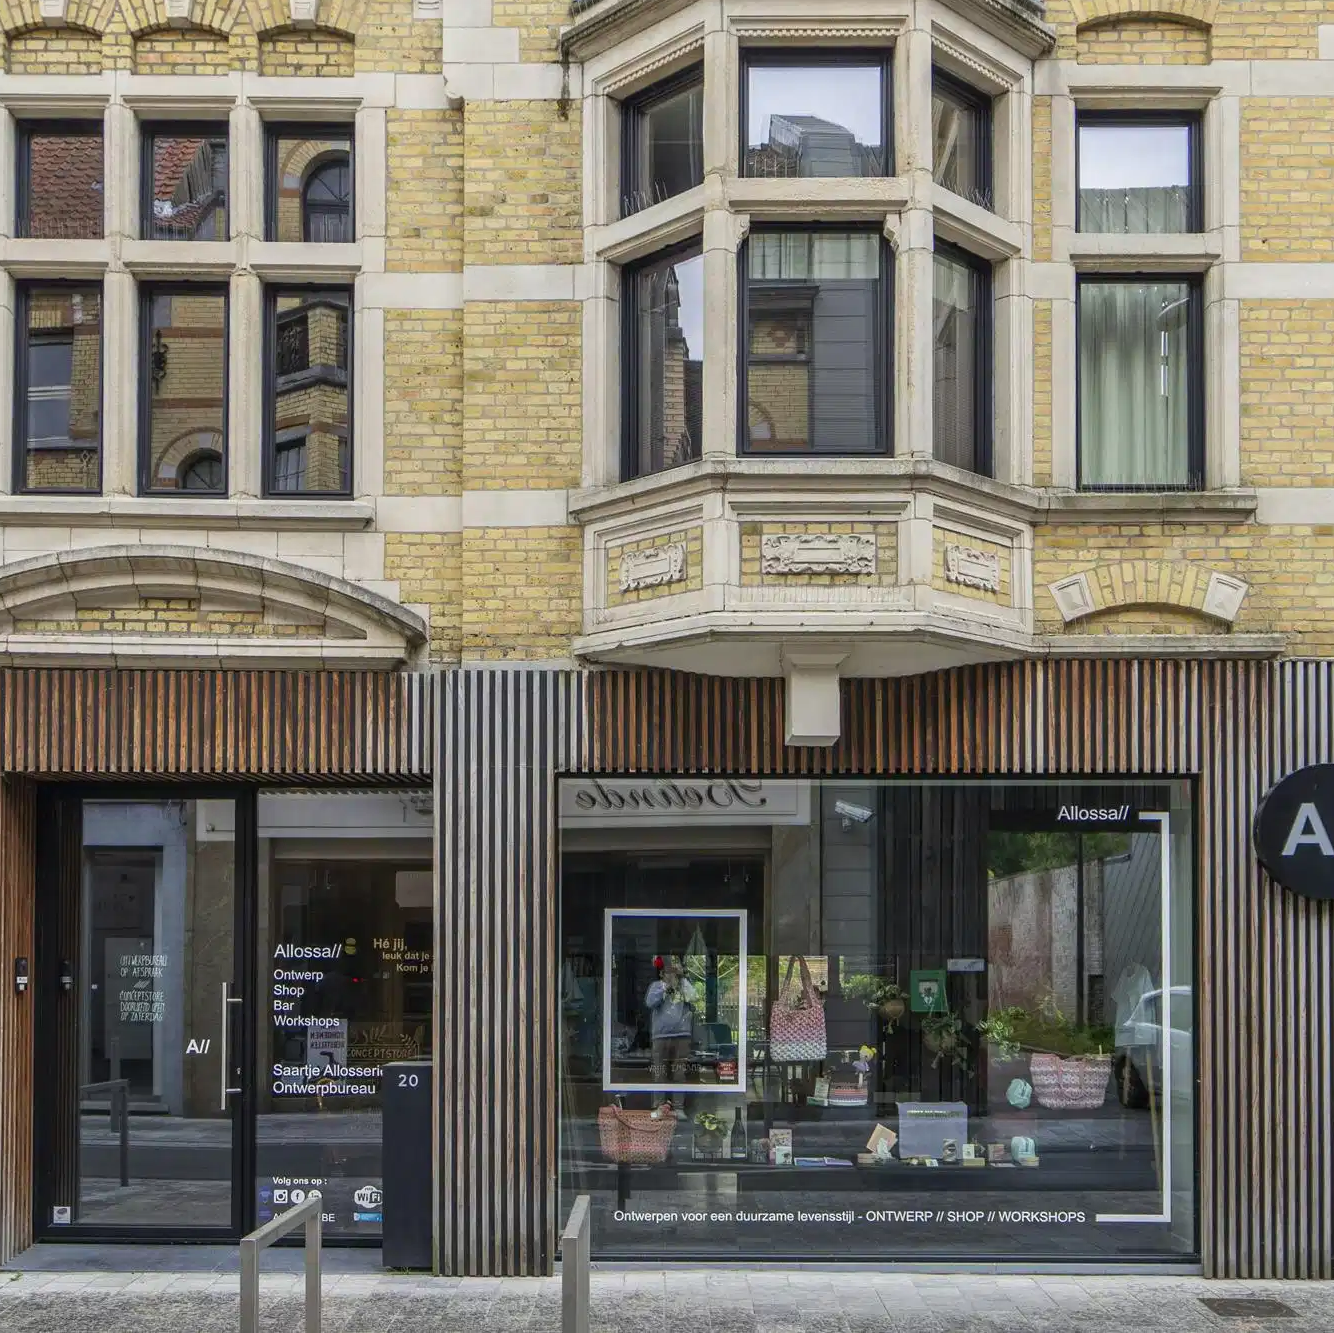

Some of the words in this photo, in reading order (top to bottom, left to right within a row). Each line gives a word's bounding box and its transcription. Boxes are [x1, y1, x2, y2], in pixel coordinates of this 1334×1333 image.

[373, 938, 390, 950] Hé
[393, 938, 408, 951] jij,
[382, 951, 402, 960] leuk
[404, 951, 417, 960] dat
[421, 952, 430, 962] je
[396, 964, 417, 972] Kom
[419, 964, 429, 972] je
[273, 969, 323, 982] Ontwerp
[273, 984, 304, 998] Shop
[273, 1000, 295, 1011] Bar
[273, 1015, 340, 1028] Workshops
[273, 1064, 320, 1080] Saartje
[398, 1074, 419, 1087] 20
[273, 1082, 376, 1096] Ontwerpbureau
[272, 1177, 291, 1186] Volg
[311, 1178, 322, 1187] op
[613, 1210, 677, 1224] Ontwerpen
[681, 1212, 707, 1222] voor
[710, 1212, 732, 1222] een
[735, 1210, 794, 1222] duurzame
[797, 1210, 855, 1224] levensstijl
[865, 1210, 933, 1222] ONTWERP
[946, 1210, 985, 1222] SHOP
[998, 1210, 1086, 1223] WORKSHOPS
